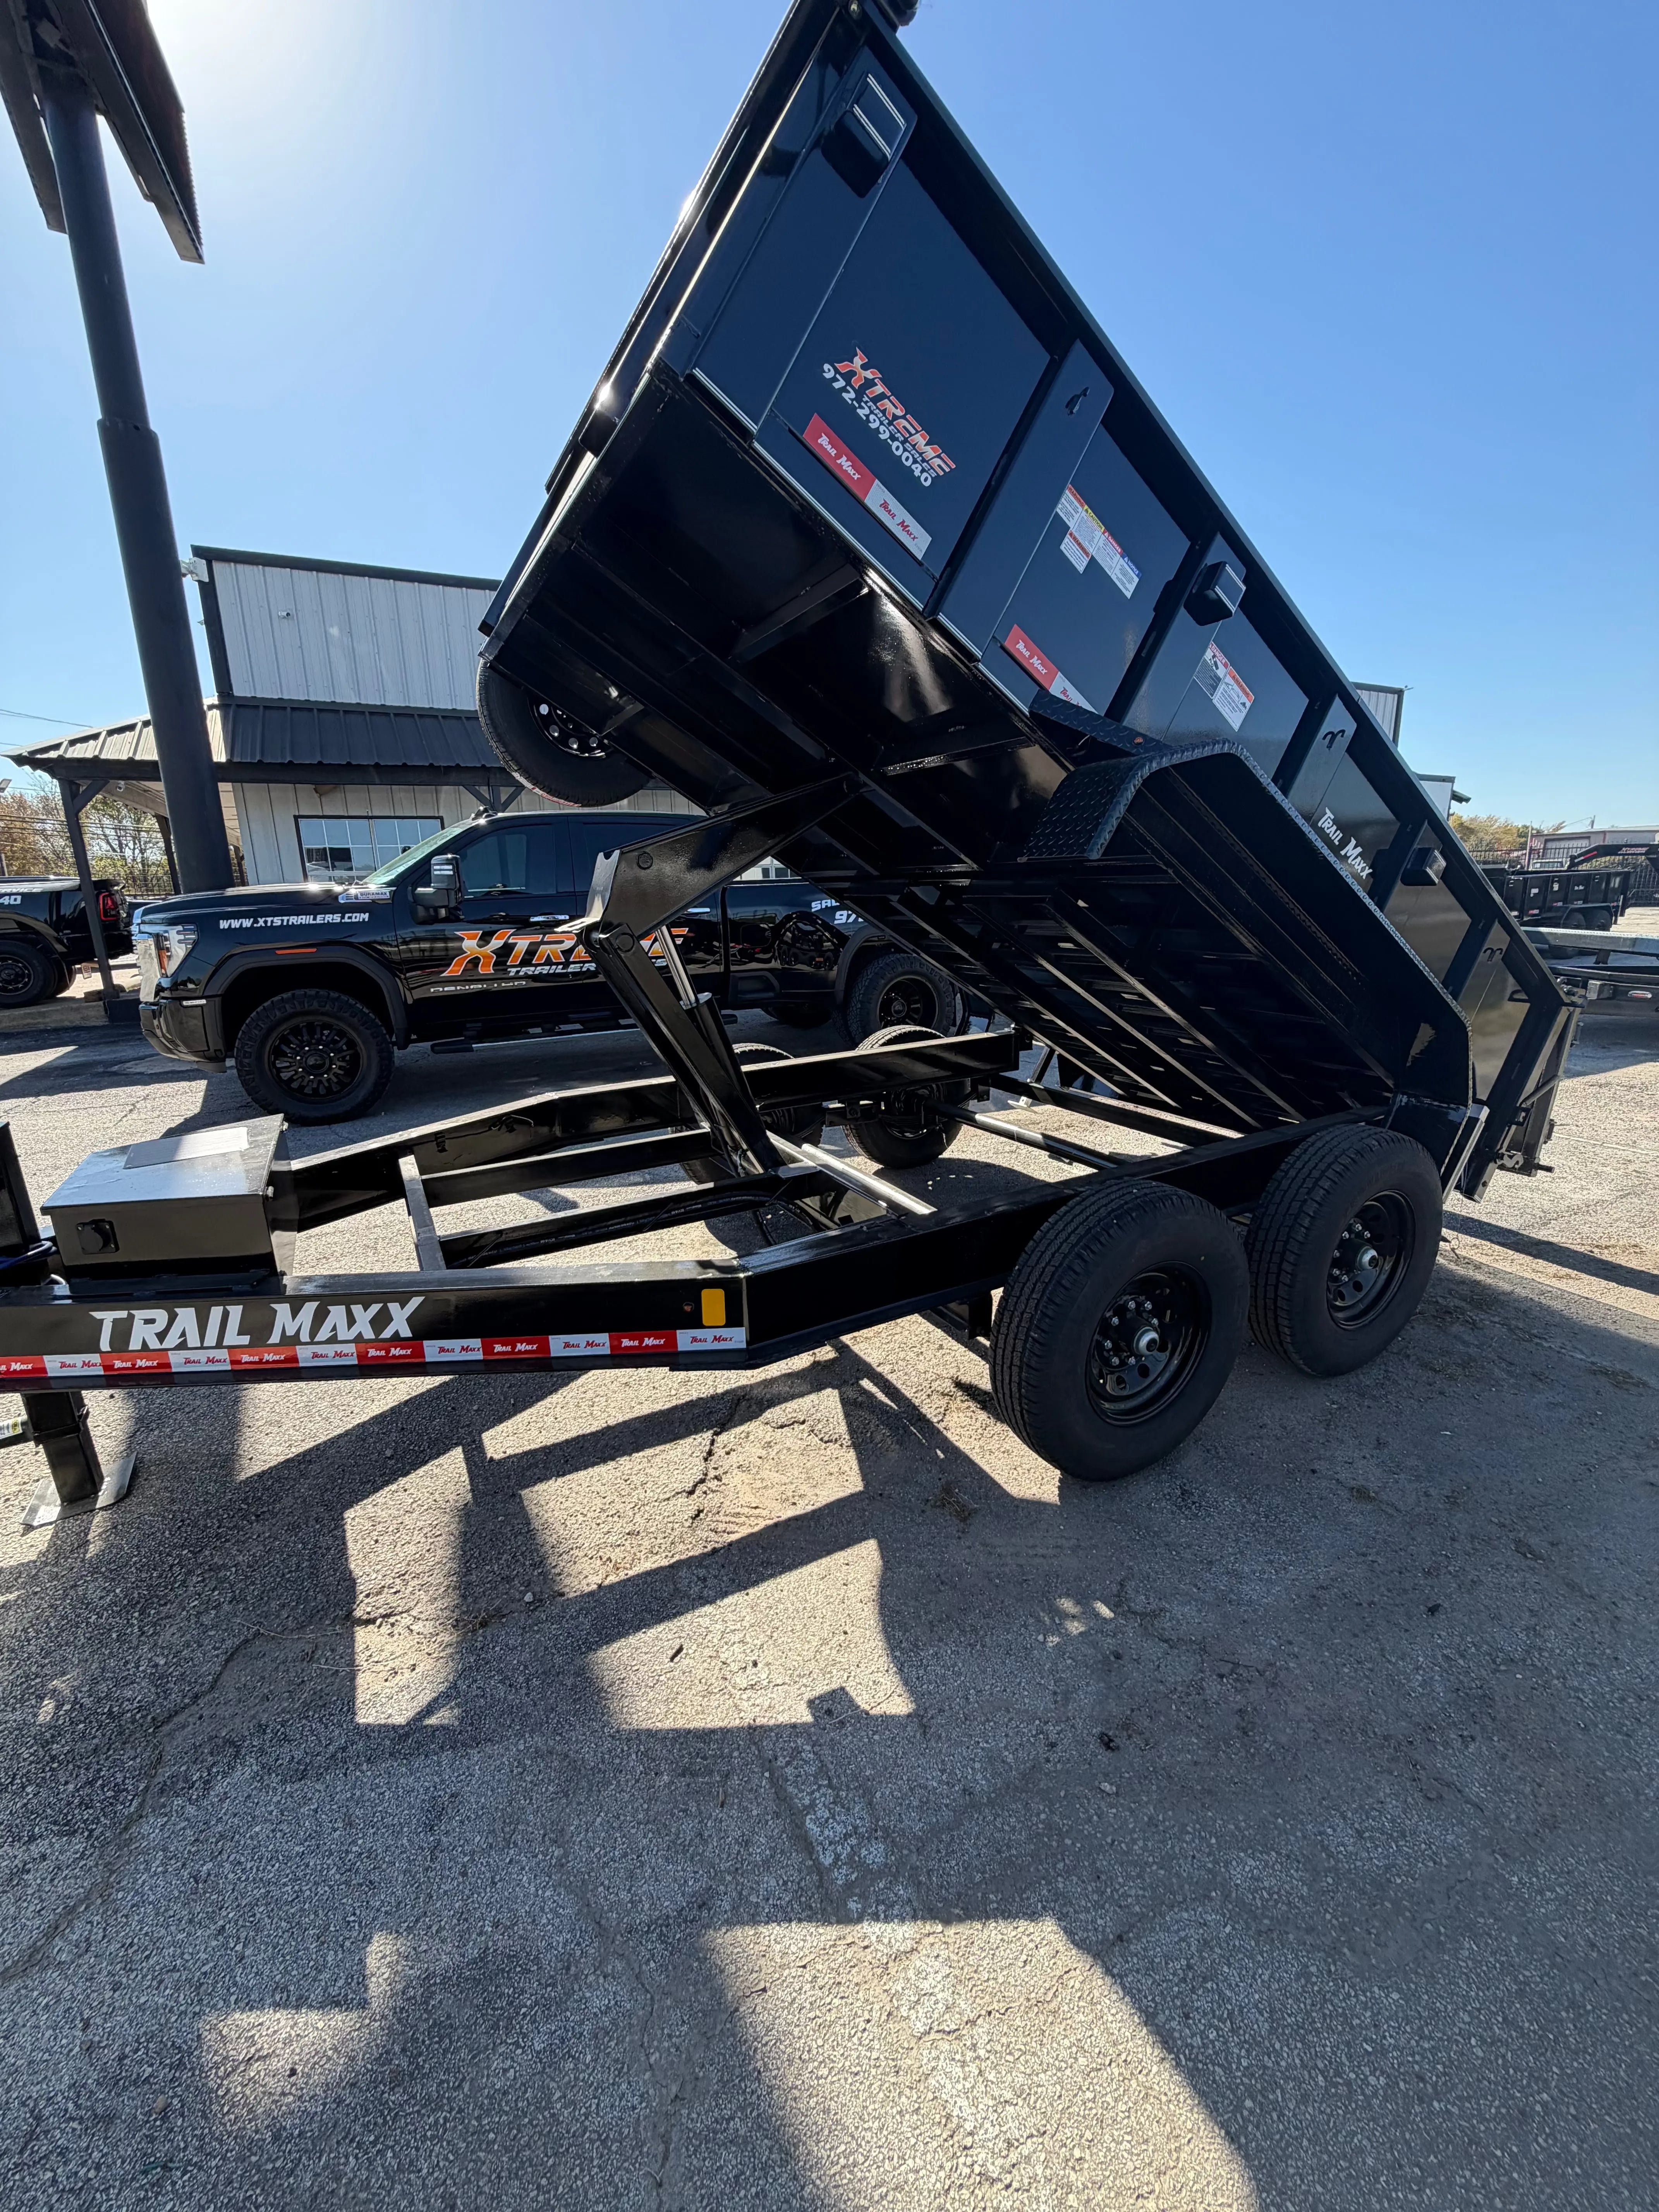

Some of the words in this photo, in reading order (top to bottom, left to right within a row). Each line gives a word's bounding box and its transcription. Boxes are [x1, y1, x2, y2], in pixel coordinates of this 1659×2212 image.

[834, 347, 956, 476] XTREME
[823, 363, 932, 487] 972-299-0040
[863, 394, 904, 442] TRAILER
[904, 442, 937, 477] SALES
[817, 432, 837, 457] TRAIL
[836, 455, 861, 480] MAXX
[879, 498, 897, 520] TRAIL
[896, 519, 919, 542] MAXX
[1089, 512, 1103, 530] CAUTION
[1016, 639, 1030, 658] TRAIL
[1029, 655, 1048, 675] MAXX
[1211, 646, 1226, 664] DANGER
[1318, 807, 1343, 845] TRAIL
[1340, 836, 1373, 880] MAXX
[0, 895, 22, 905] 40
[220, 912, 369, 929] WWW.XTSTRAILERS.COM
[834, 910, 864, 924] 97
[89, 1305, 251, 1351] TRAIL
[266, 1296, 426, 1344] MAXX
[562, 1341, 580, 1349] TRAIL
[584, 1340, 607, 1349] MAXX
[621, 1339, 639, 1347] TRAIL
[642, 1337, 666, 1346] MAXX
[690, 1336, 708, 1344] TRAIL
[711, 1335, 734, 1343] MAXX
[367, 1348, 386, 1357] TRAIL
[388, 1347, 412, 1356] MAXX
[459, 1345, 482, 1353] MAXX
[493, 1344, 512, 1352] TRAIL
[515, 1343, 538, 1351] MAXX
[183, 1357, 201, 1365] TRAIL
[205, 1356, 227, 1364] MAXX
[240, 1354, 259, 1363] TRAIL
[263, 1353, 286, 1362] MAXX
[311, 1352, 329, 1360] TRAIL
[332, 1350, 356, 1358] MAXX
[9, 1362, 33, 1371] MAXX
[113, 1360, 132, 1368] TRAIL
[135, 1359, 158, 1367] MAXX
